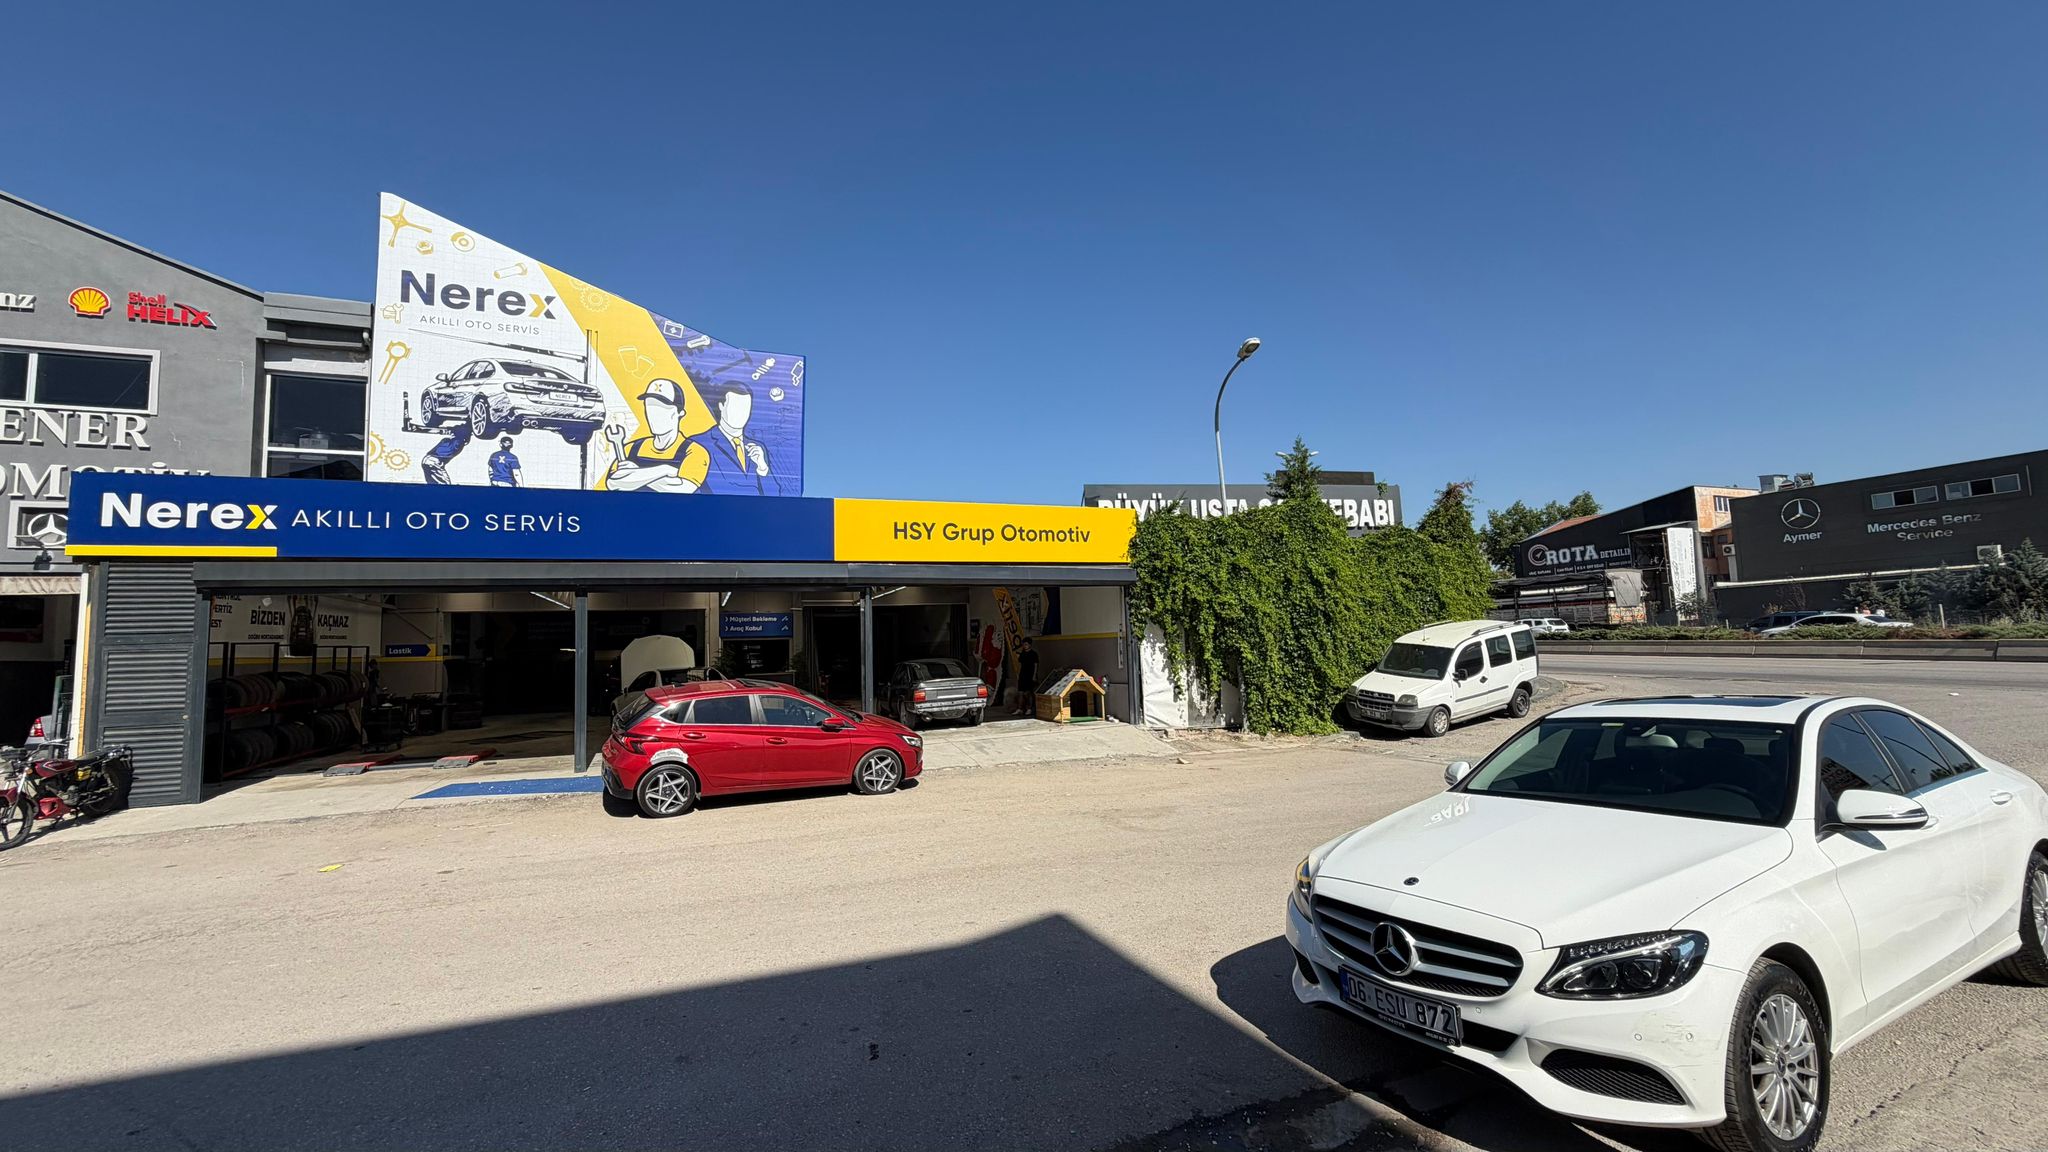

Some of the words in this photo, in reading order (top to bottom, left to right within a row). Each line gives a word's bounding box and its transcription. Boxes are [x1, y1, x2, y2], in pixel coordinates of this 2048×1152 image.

[128, 292, 166, 307] Shell
[401, 269, 557, 320] Nerex
[127, 303, 215, 328] HELIX
[420, 315, 459, 327] AKILLI
[465, 320, 492, 330] OTO
[497, 323, 540, 335] SERVİS
[101, 492, 278, 530] Nerex
[291, 509, 390, 529] AKILLI
[406, 511, 470, 530] OTO
[484, 512, 581, 533] SERVİS
[1321, 499, 1396, 527] EBABI
[1867, 517, 1936, 533] Mercedes
[1941, 512, 1982, 526] Benz
[893, 521, 936, 541] HSY
[942, 522, 995, 546] Grup
[1000, 523, 1091, 543] Otomotiv
[1783, 531, 1822, 544] Aymer
[1896, 528, 1954, 542] Service
[1544, 544, 1599, 565] ROTA
[250, 605, 286, 626] BİZDEN
[317, 613, 349, 632] KAÇMAZ
[388, 647, 412, 655] Lastik
[1349, 976, 1366, 1003] 06
[1375, 987, 1408, 1019] ESU
[1415, 1001, 1454, 1035] 872
